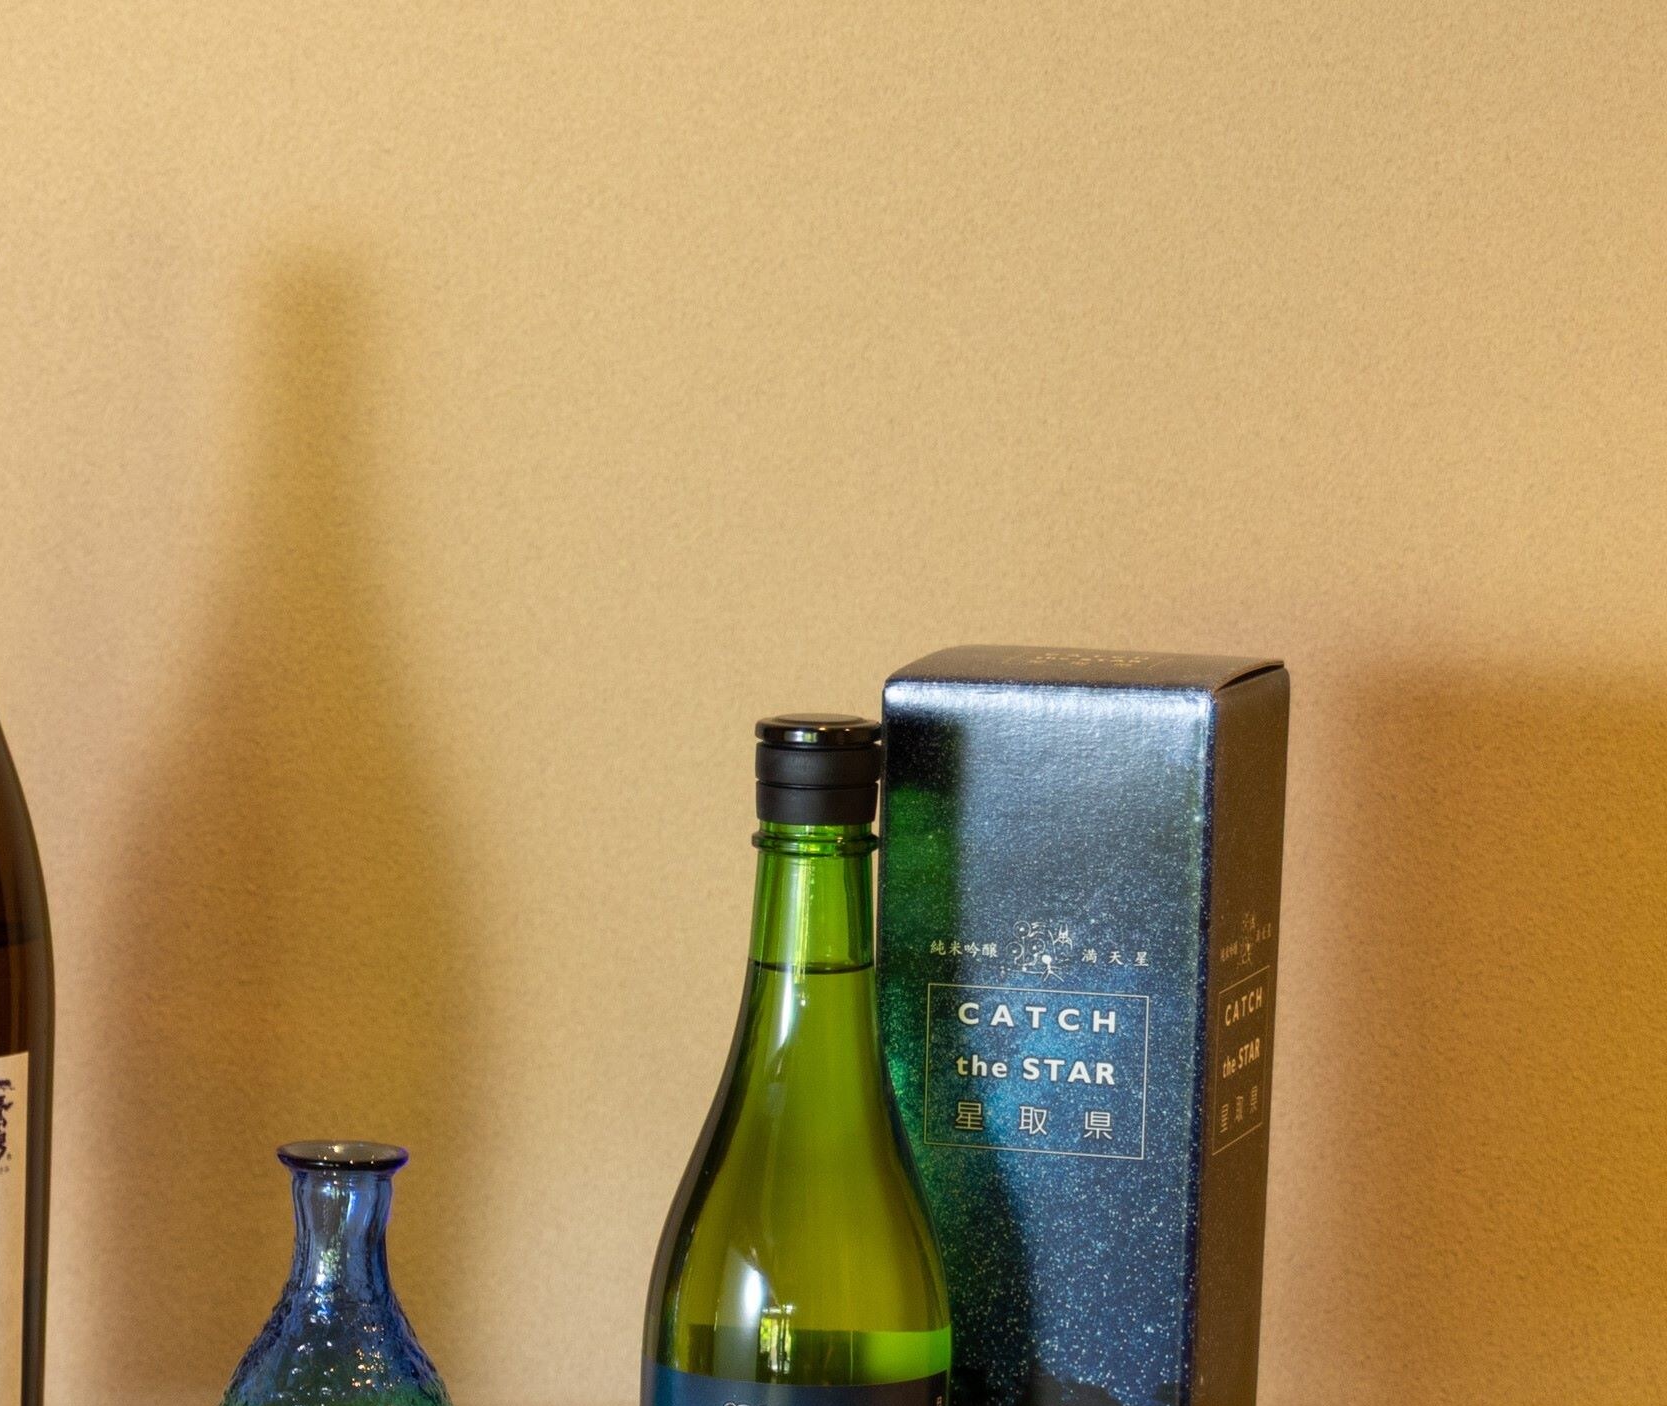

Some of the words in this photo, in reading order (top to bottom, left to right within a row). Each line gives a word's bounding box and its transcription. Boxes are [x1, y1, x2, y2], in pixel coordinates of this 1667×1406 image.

[930, 940, 998, 959] 純米吟醸
[1082, 948, 1149, 968] 満天星
[957, 1002, 1116, 1034] CATCH
[1225, 986, 1263, 1026] CATCH
[955, 1055, 1008, 1079] the
[1023, 1058, 1115, 1086] STAR
[1222, 1055, 1237, 1079] the
[1238, 1038, 1261, 1070] STAR
[954, 1101, 1114, 1141] 星取県
